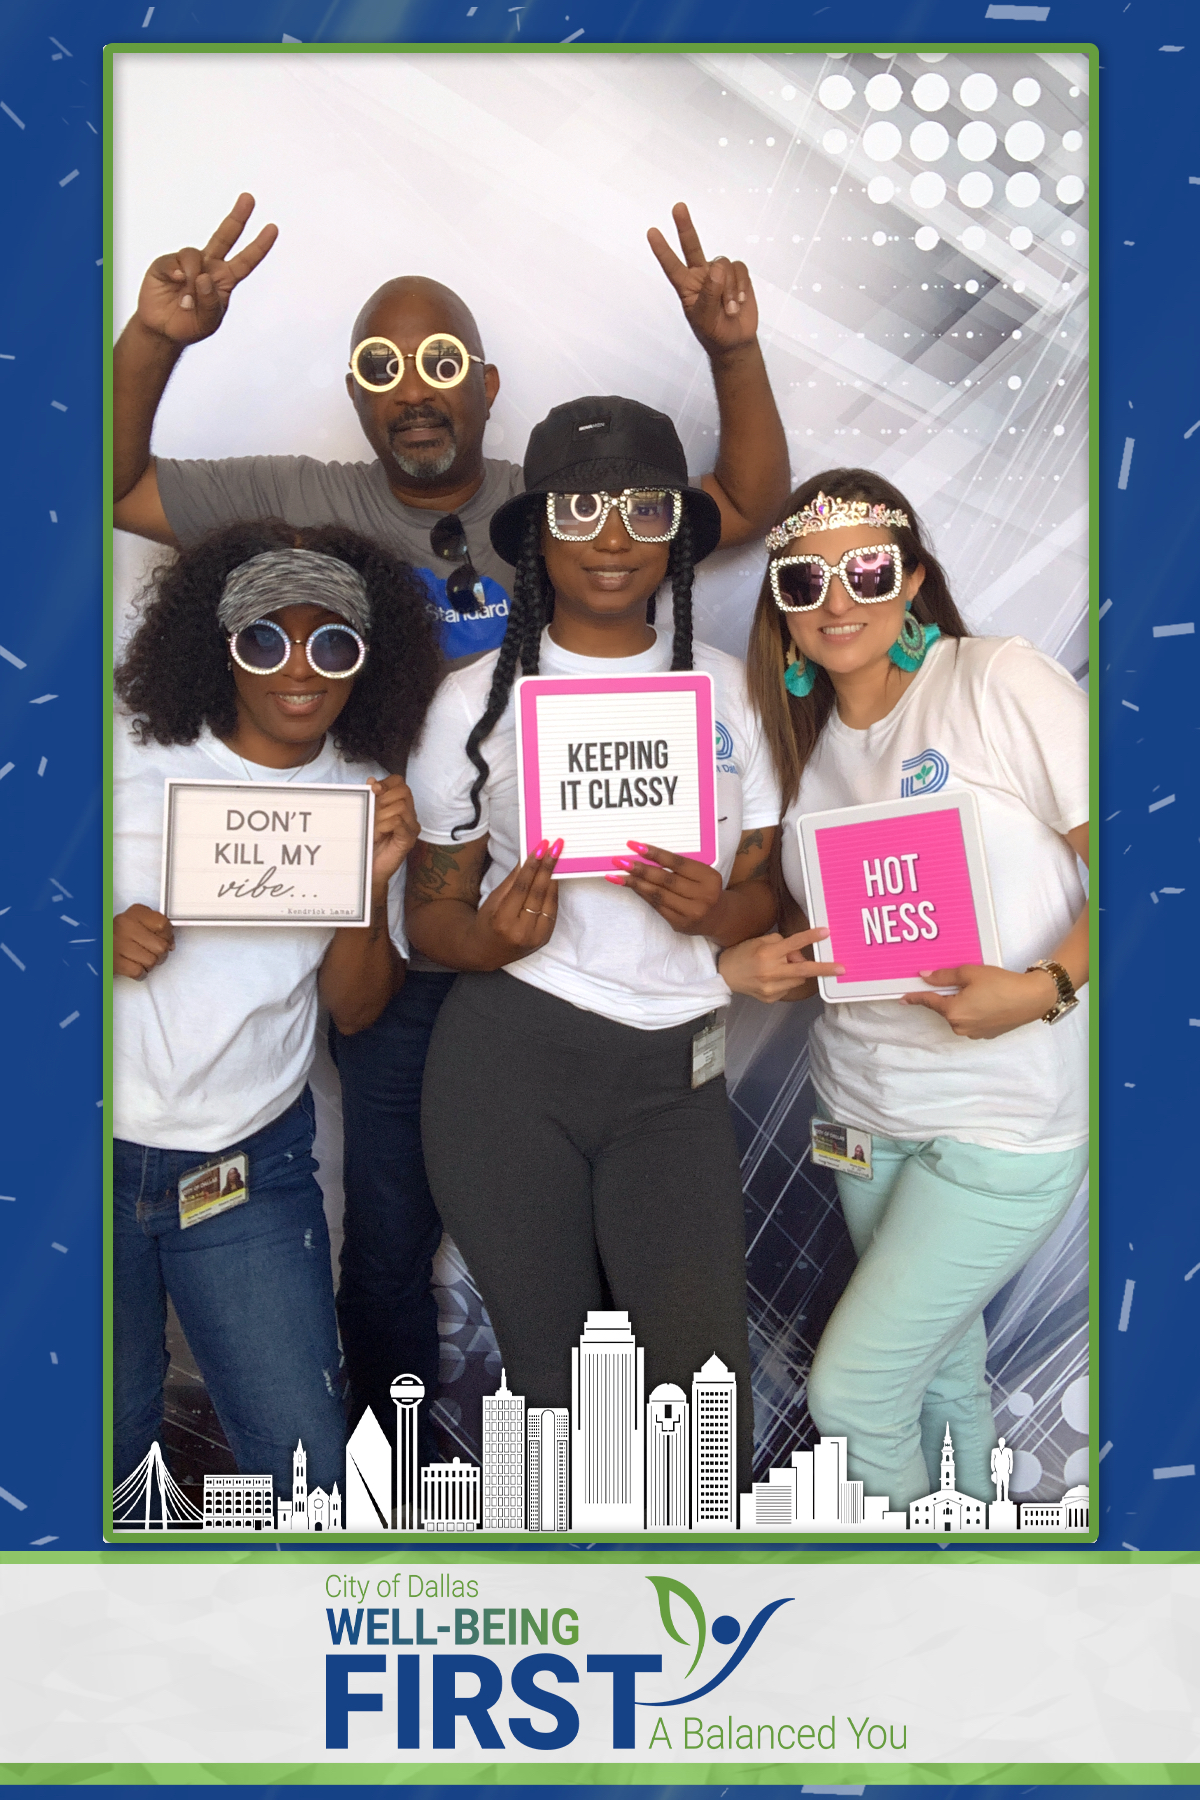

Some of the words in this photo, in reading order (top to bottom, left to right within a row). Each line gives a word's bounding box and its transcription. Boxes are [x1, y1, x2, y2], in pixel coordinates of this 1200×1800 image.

[568, 739, 669, 773] KEEPING
[560, 780, 581, 811] IT
[588, 775, 678, 809] CLASSY
[226, 809, 312, 832] DON'T
[214, 842, 264, 865] KILL
[281, 844, 322, 866] MY
[217, 866, 318, 898] vibe...
[863, 853, 919, 897] HOT
[861, 901, 939, 945] NESS
